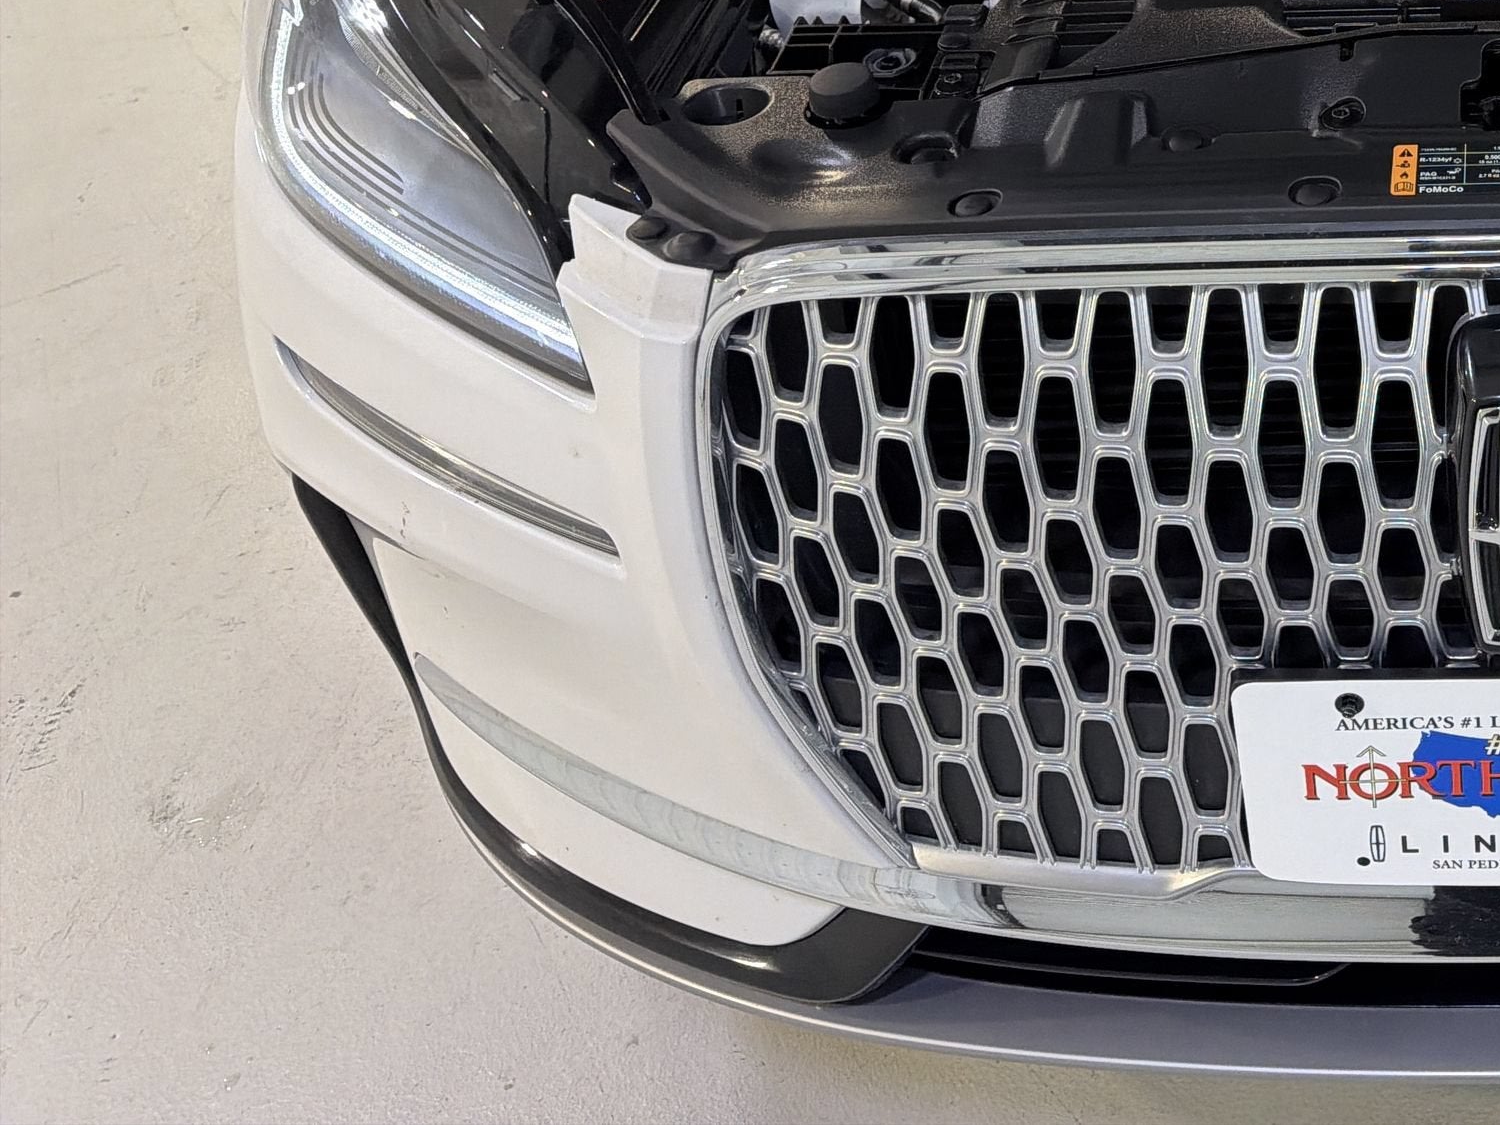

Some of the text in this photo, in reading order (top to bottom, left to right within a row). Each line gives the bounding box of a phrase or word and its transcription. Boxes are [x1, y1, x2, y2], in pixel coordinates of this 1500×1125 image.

[1335, 716, 1455, 731] AMERICA'S
[1460, 716, 1482, 729] #1
[1432, 858, 1463, 870] SAN
